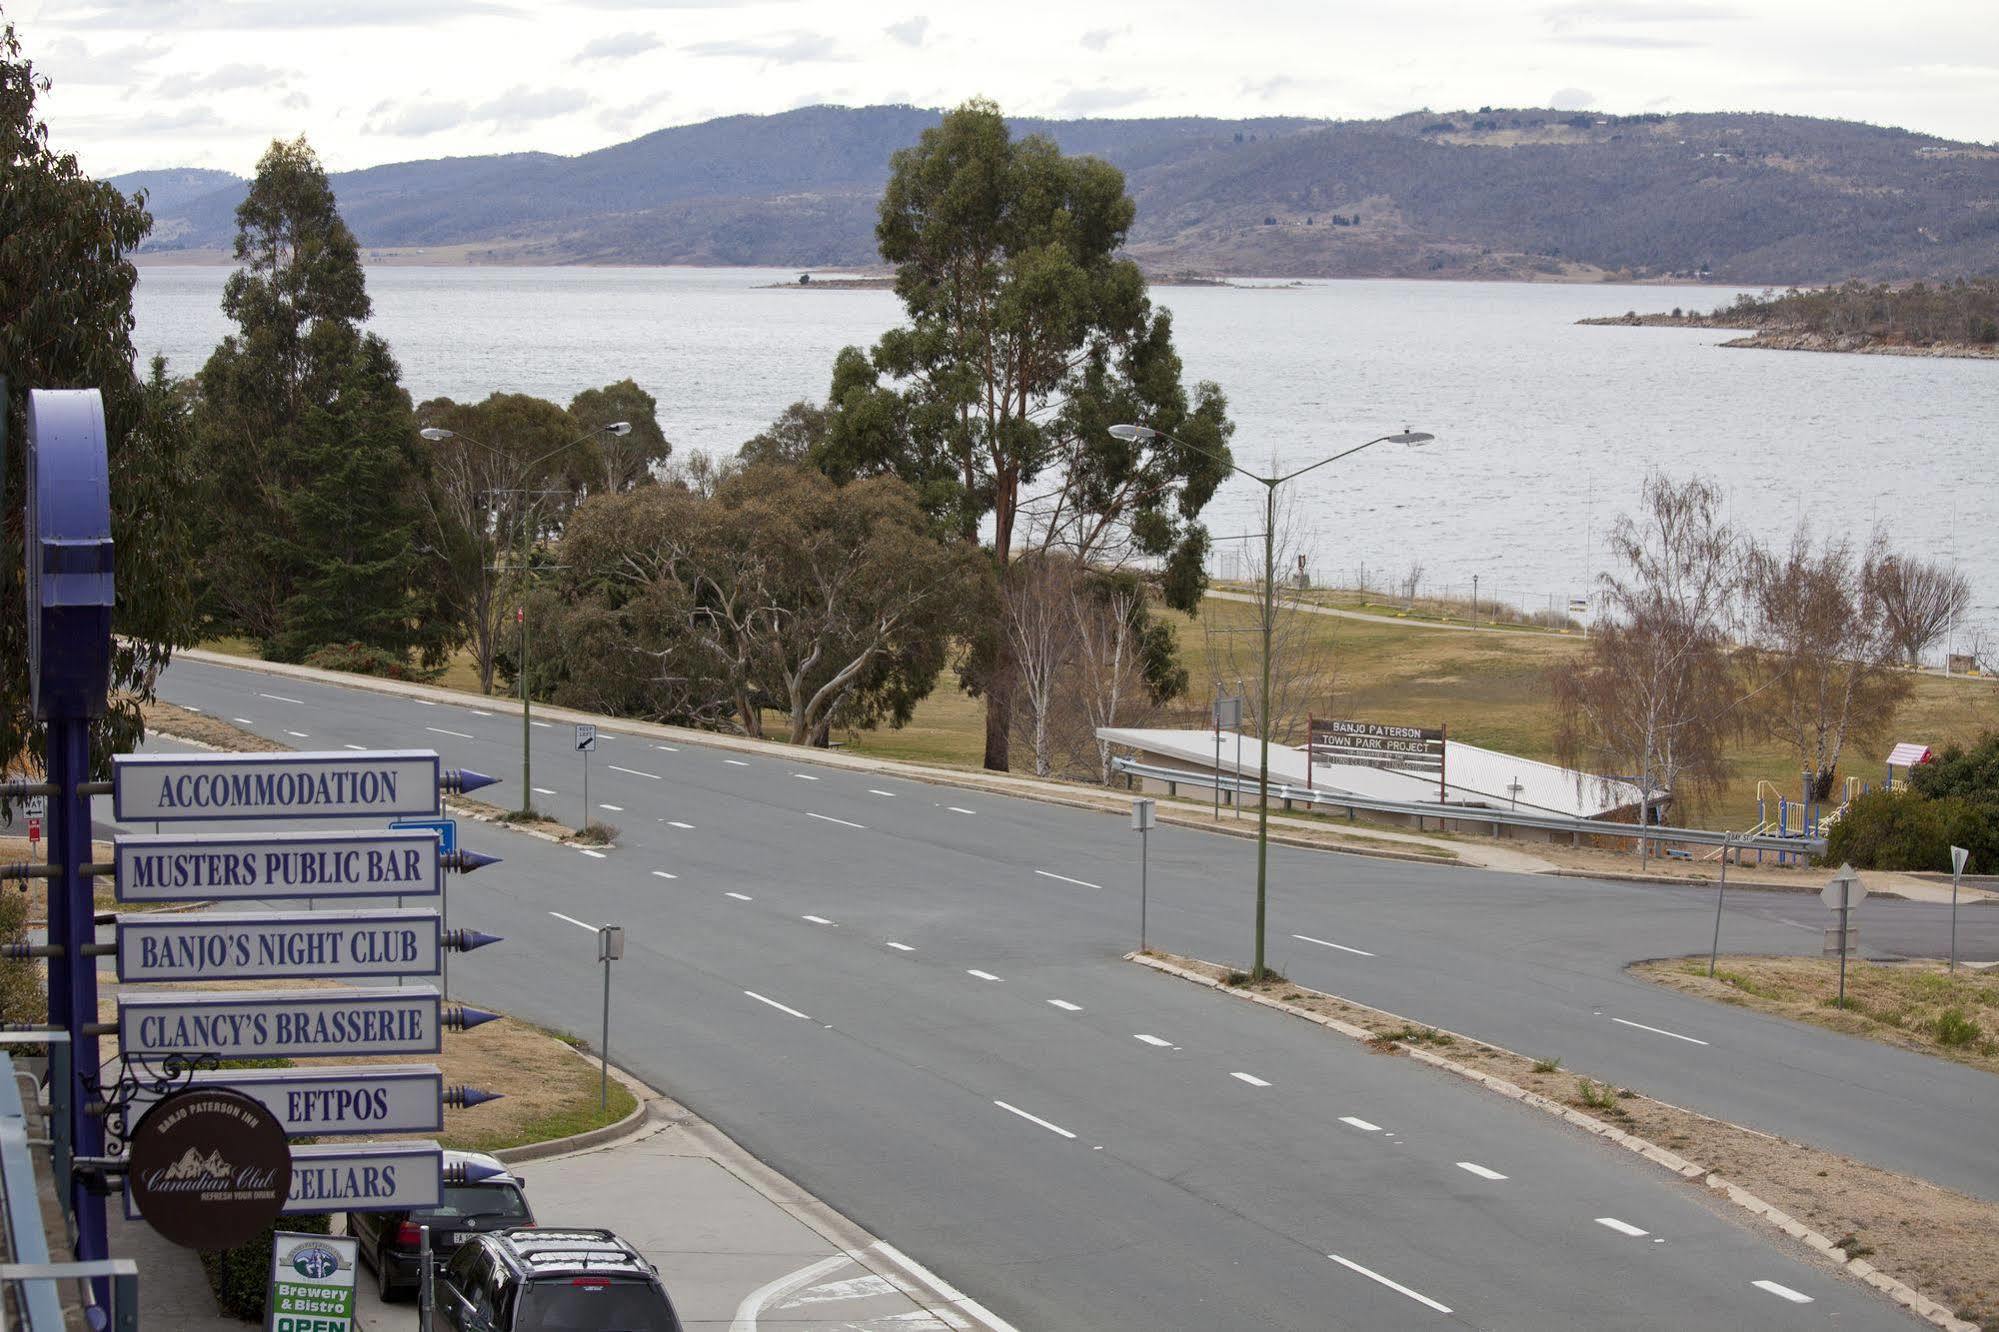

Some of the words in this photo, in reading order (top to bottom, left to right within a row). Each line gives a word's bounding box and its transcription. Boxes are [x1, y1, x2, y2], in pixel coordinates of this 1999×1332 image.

[1322, 735, 1351, 746] TOWN
[1355, 738, 1382, 749] PARK
[1387, 741, 1429, 752] PROJECT
[1333, 722, 1365, 734] BANJO
[1369, 725, 1421, 738] PATERSON
[157, 770, 399, 808] ACCOMMODATION
[132, 852, 257, 888] MUSTERS
[264, 850, 361, 886] PUBLIC
[366, 849, 422, 882] BAR
[140, 933, 251, 972] BANJO'S
[258, 930, 343, 966] NIGHT
[350, 929, 418, 963] CLUB
[140, 1012, 269, 1049] CLANCY'S
[275, 1009, 423, 1045] BRASSERIE
[158, 1107, 188, 1134] BANJO
[189, 1101, 241, 1118] PATERSON
[242, 1111, 260, 1128] INN
[287, 1087, 388, 1122] EFTPOS
[142, 1168, 230, 1192] Canadian
[288, 1165, 397, 1200] CELLARS
[201, 1191, 232, 1201] REFRESH
[234, 1191, 253, 1200] YOUR
[254, 1190, 275, 1199] DRINK
[278, 1284, 348, 1302] Brewery
[281, 1299, 292, 1310] &
[294, 1299, 345, 1314] Bistro
[278, 1317, 346, 1332] OPEN
